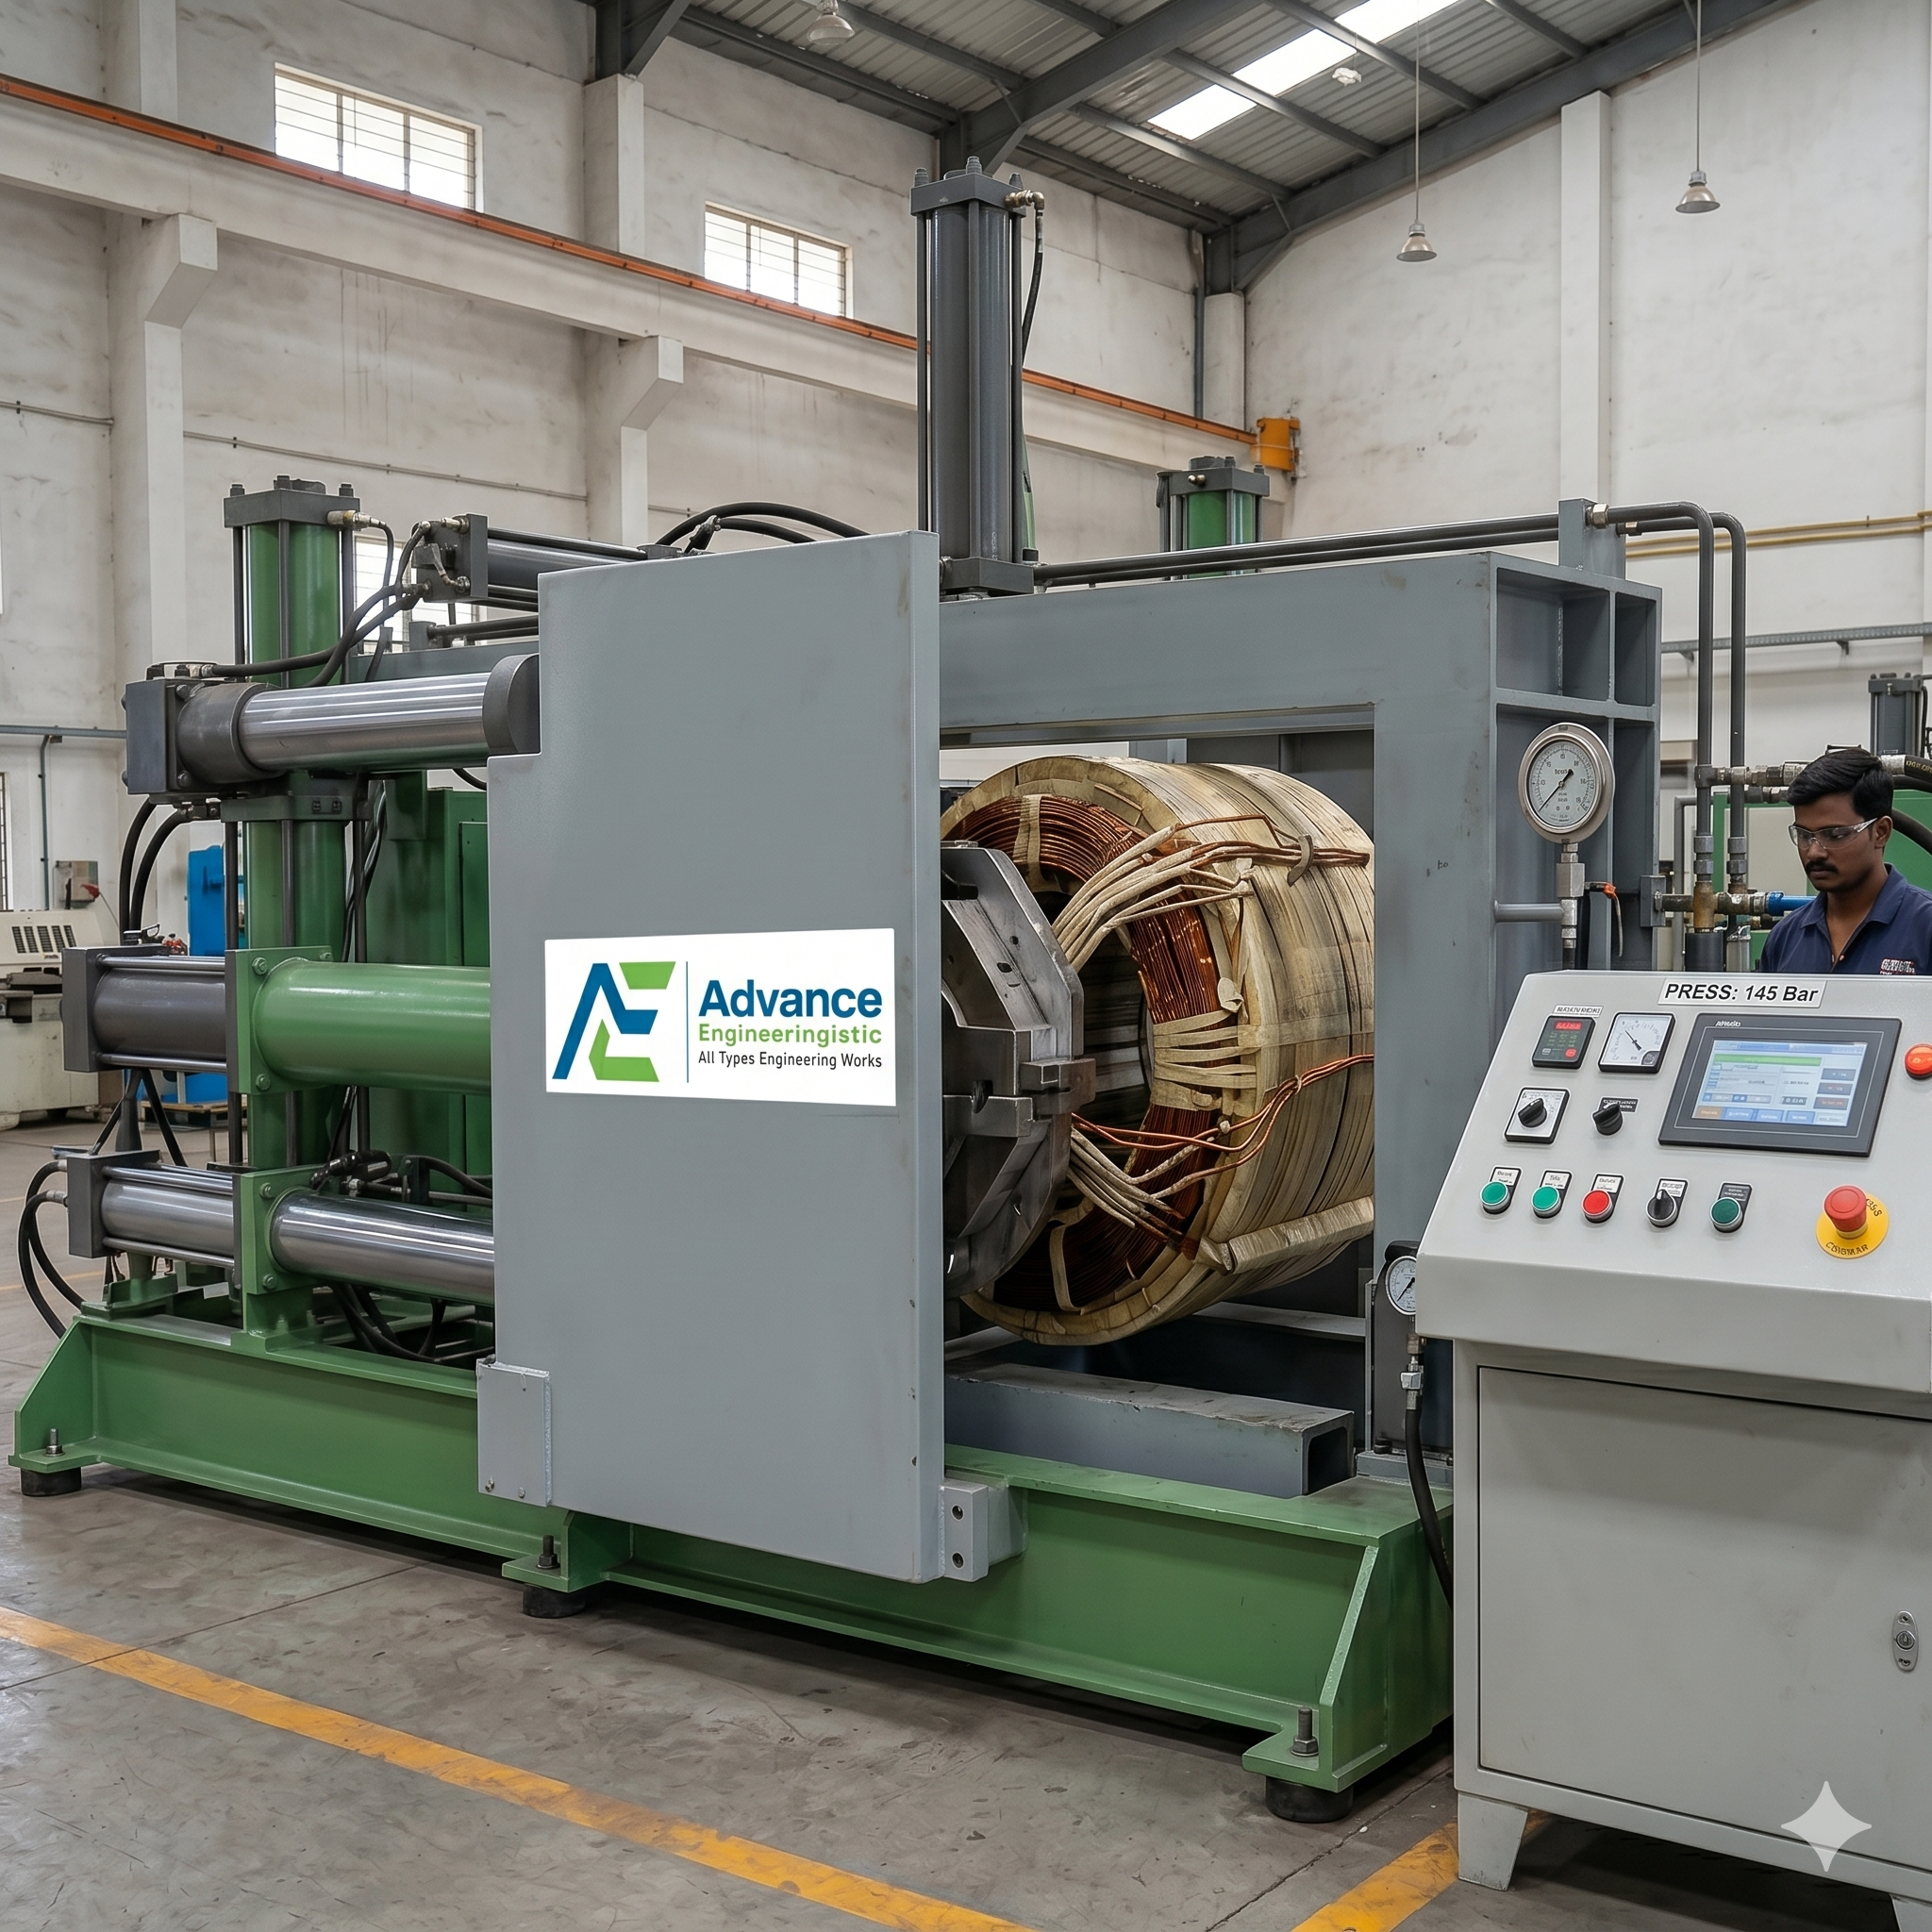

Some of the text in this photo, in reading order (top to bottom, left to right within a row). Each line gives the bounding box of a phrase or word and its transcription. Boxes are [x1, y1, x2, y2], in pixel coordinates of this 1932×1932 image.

[698, 979, 883, 1018] Advance
[1665, 984, 1819, 1002] PRESS: 145 Bar
[699, 1024, 883, 1048] Engineeringistic
[698, 1051, 882, 1070] All Types Engineering Works
